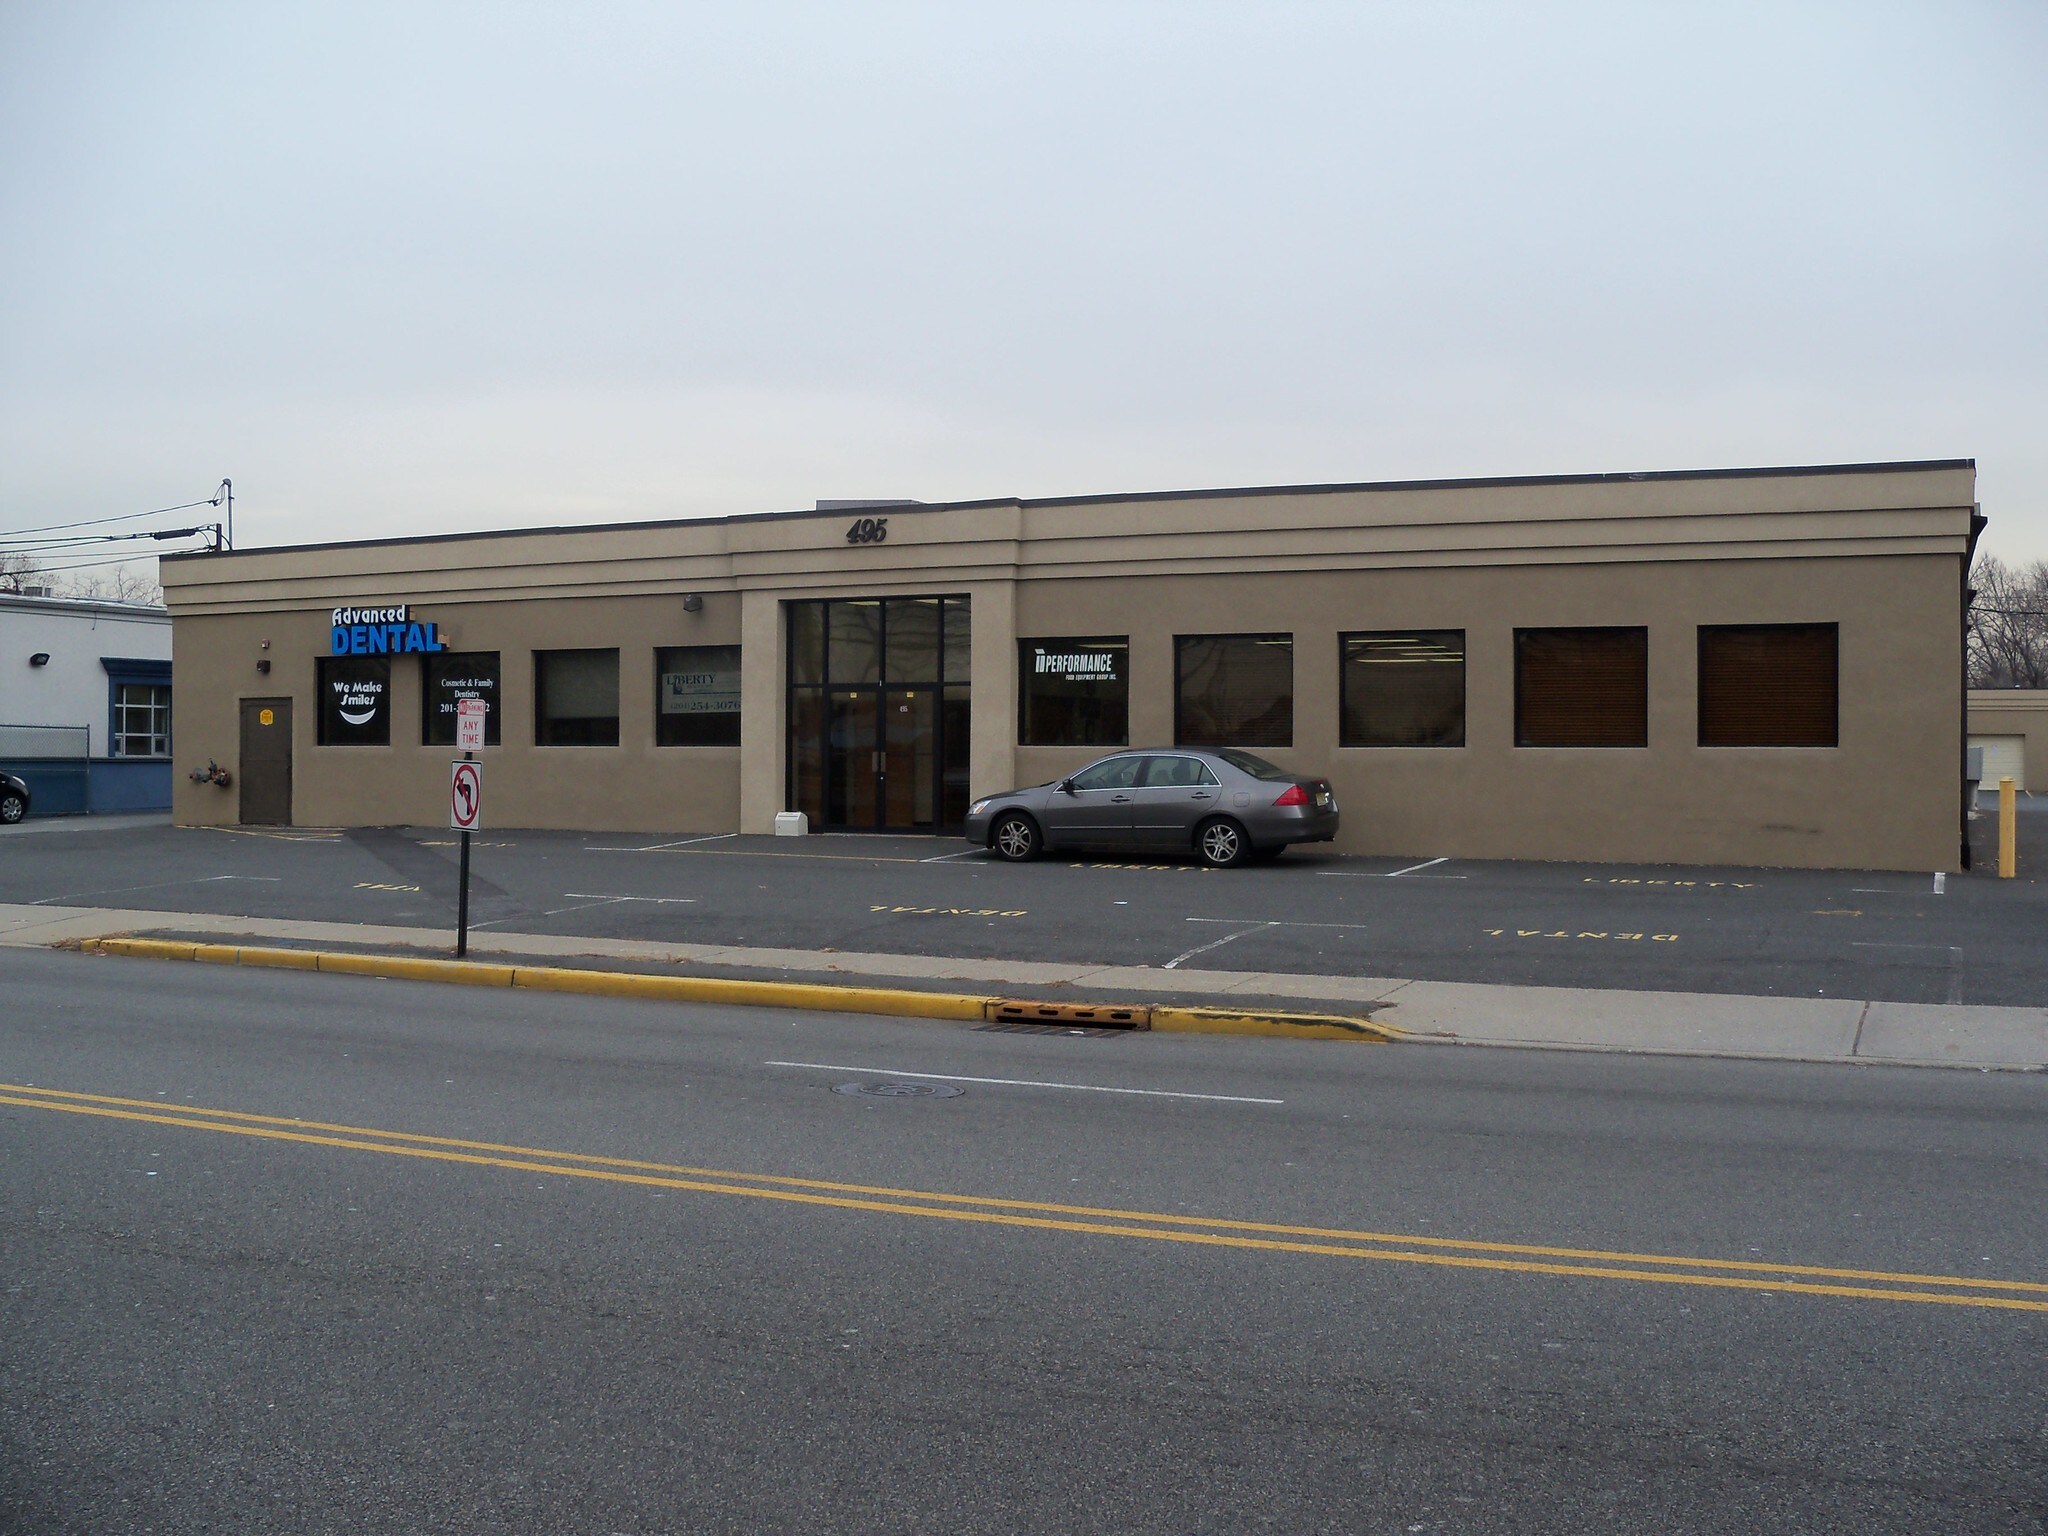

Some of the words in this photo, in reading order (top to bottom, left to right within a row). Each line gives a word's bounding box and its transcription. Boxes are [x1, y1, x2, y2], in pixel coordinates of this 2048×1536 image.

[846, 518, 888, 543] 495
[332, 604, 406, 626] Advanced
[332, 622, 442, 655] DENTAL
[1046, 654, 1112, 672] PERFORMANCE
[333, 682, 350, 693] We
[352, 681, 383, 694] Make
[441, 678, 466, 688] Cosmetic
[467, 678, 473, 687] &
[474, 678, 494, 689] Family
[340, 694, 375, 706] Smiles
[454, 689, 480, 699] Dentistry
[463, 721, 478, 731] ANY
[462, 734, 479, 744] TIME
[1483, 929, 1679, 941] DENTAL
